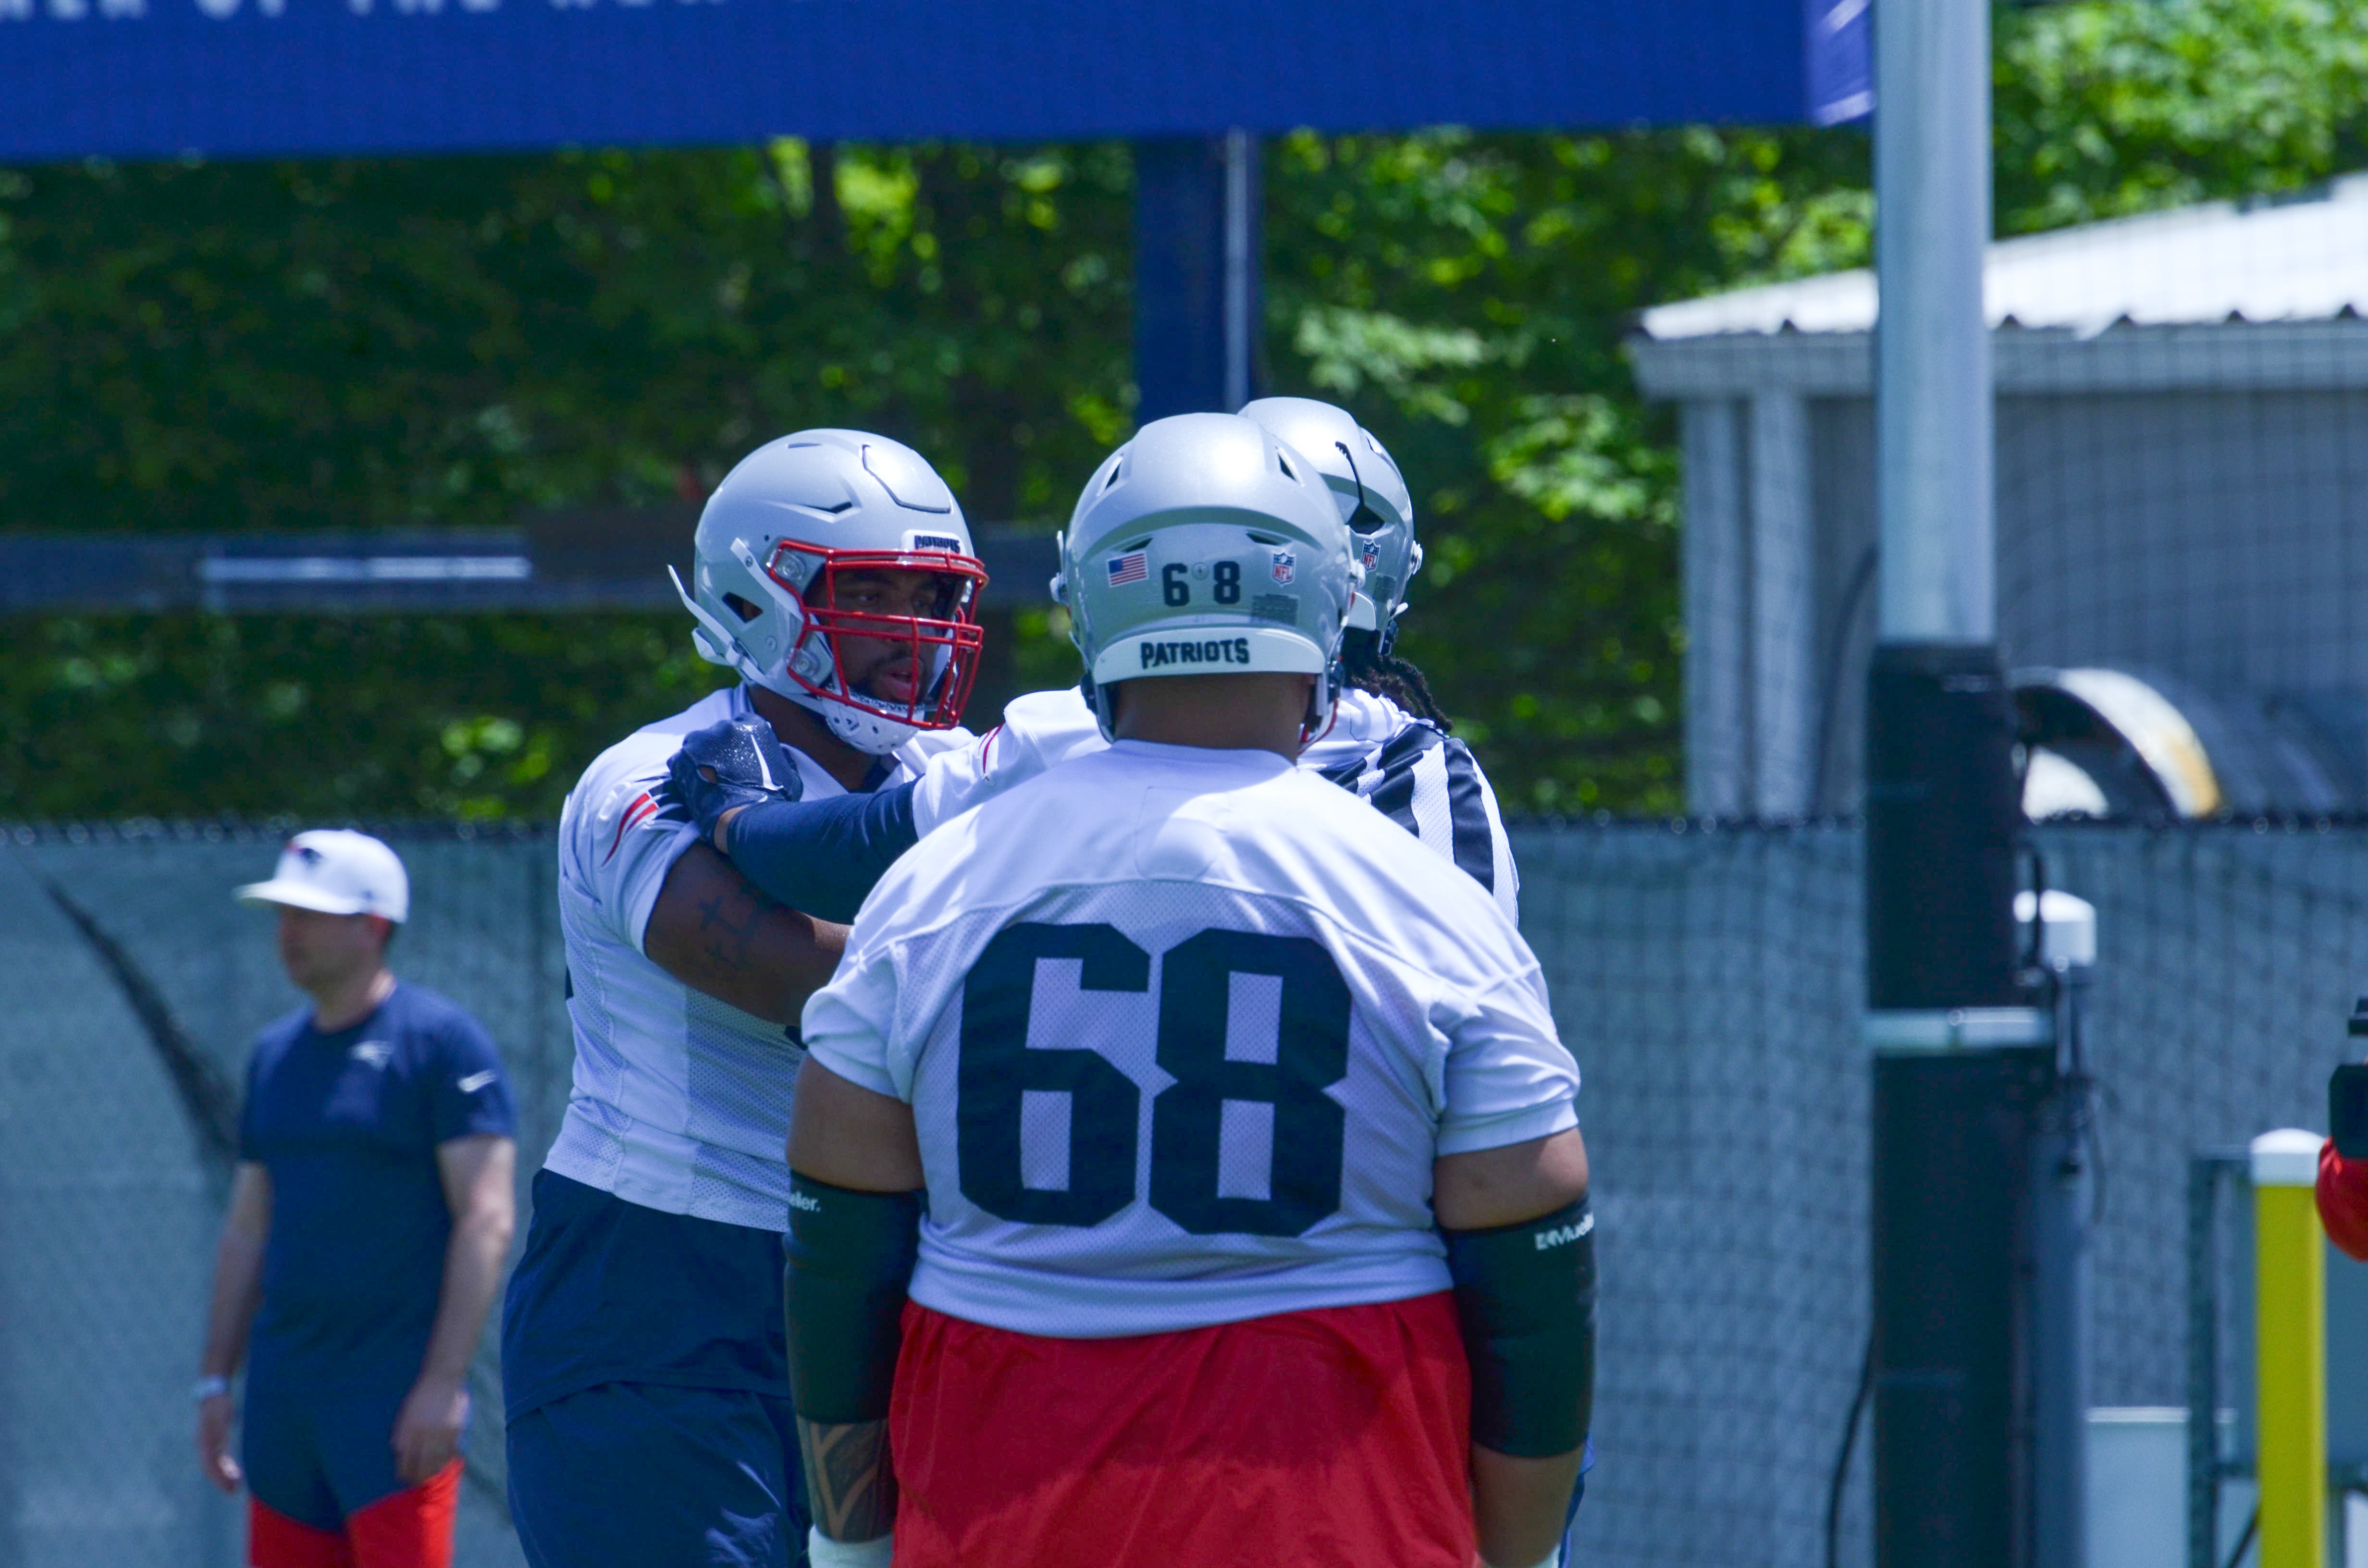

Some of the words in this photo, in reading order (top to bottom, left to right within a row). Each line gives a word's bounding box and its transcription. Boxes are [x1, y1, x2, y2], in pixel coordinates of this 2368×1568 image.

[1274, 564, 1293, 582] NFL
[1363, 552, 1377, 569] NFL
[1141, 637, 1249, 669] PATRIOTS
[957, 921, 1352, 1238] 68
